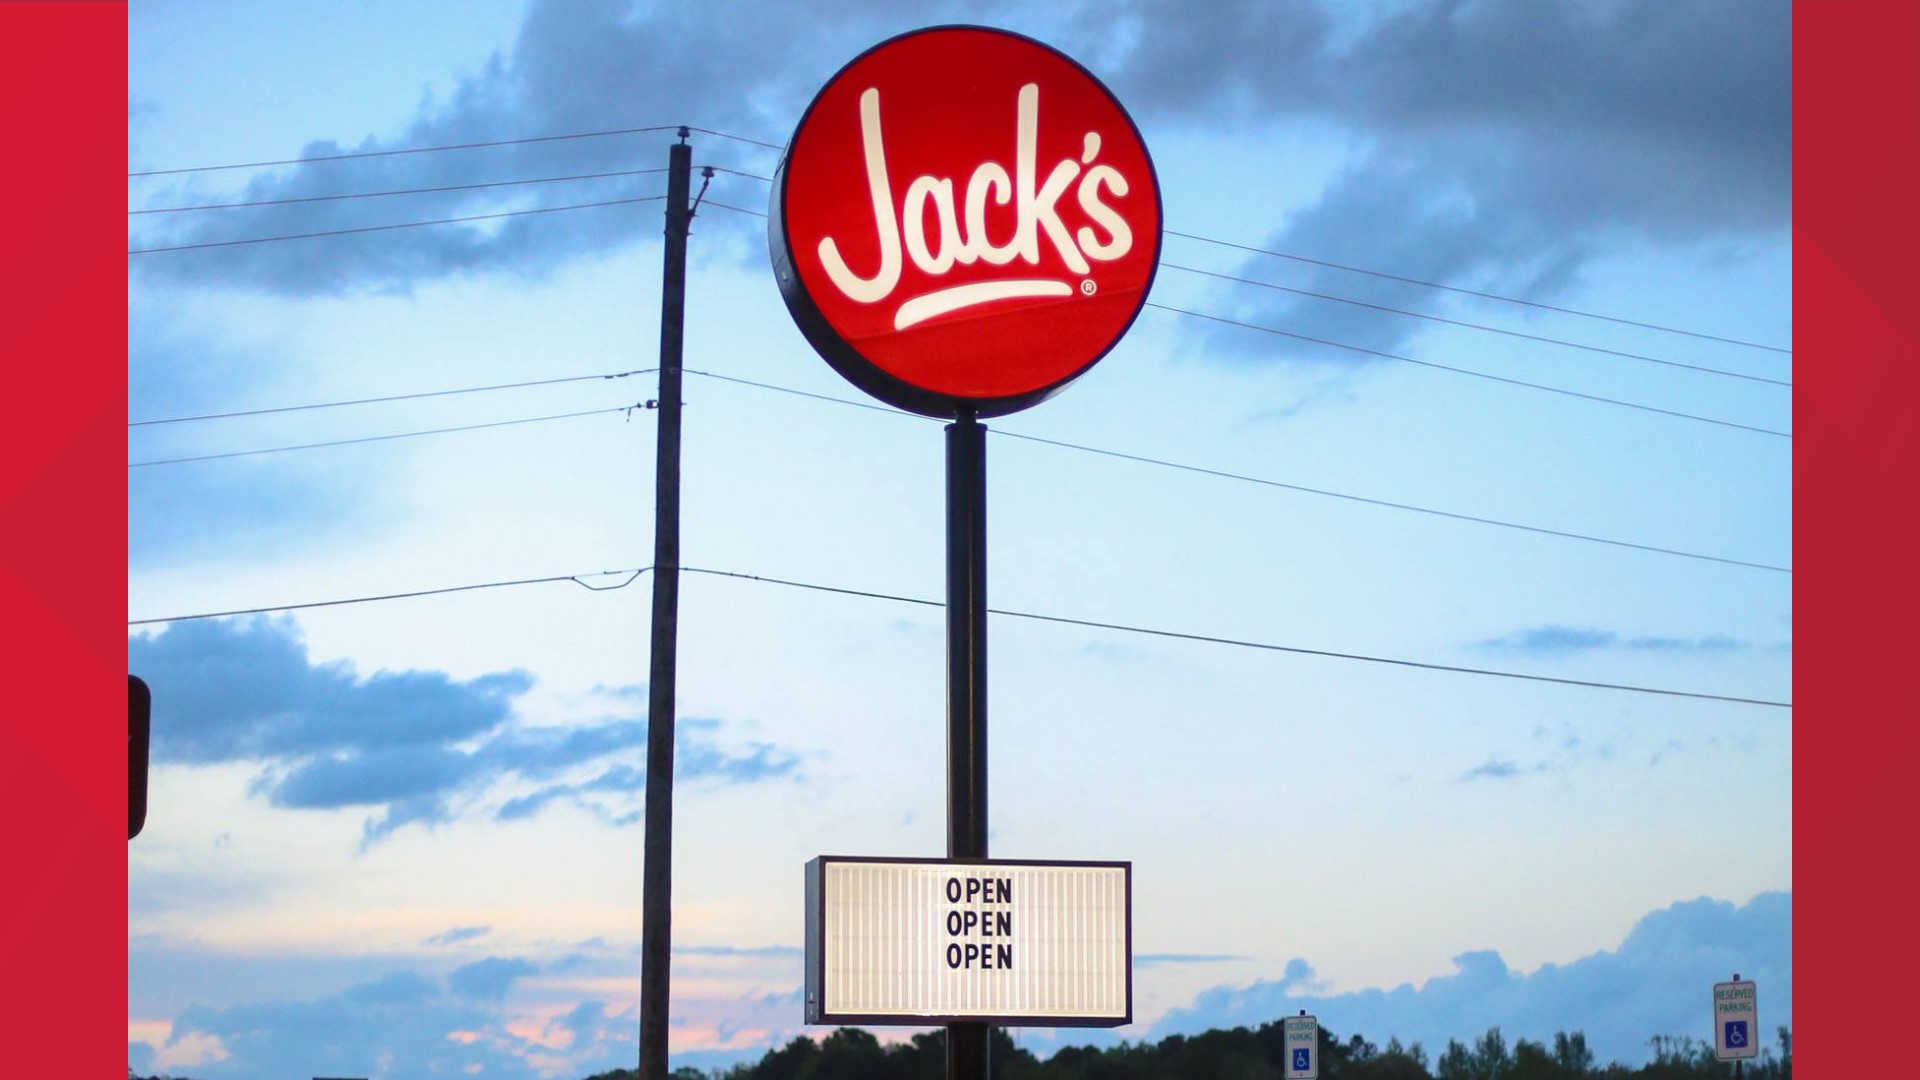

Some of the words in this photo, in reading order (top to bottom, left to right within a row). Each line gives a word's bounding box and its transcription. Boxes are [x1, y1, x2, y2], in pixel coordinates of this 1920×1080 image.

[818, 83, 1133, 303] Jack's
[946, 877, 1011, 903] OPEN
[946, 910, 1011, 936] OPEN
[946, 943, 1012, 969] OPEN
[1716, 988, 1753, 1000] RESERVED
[1719, 1002, 1752, 1013] PARKING
[1289, 1033, 1314, 1041] PARKING
